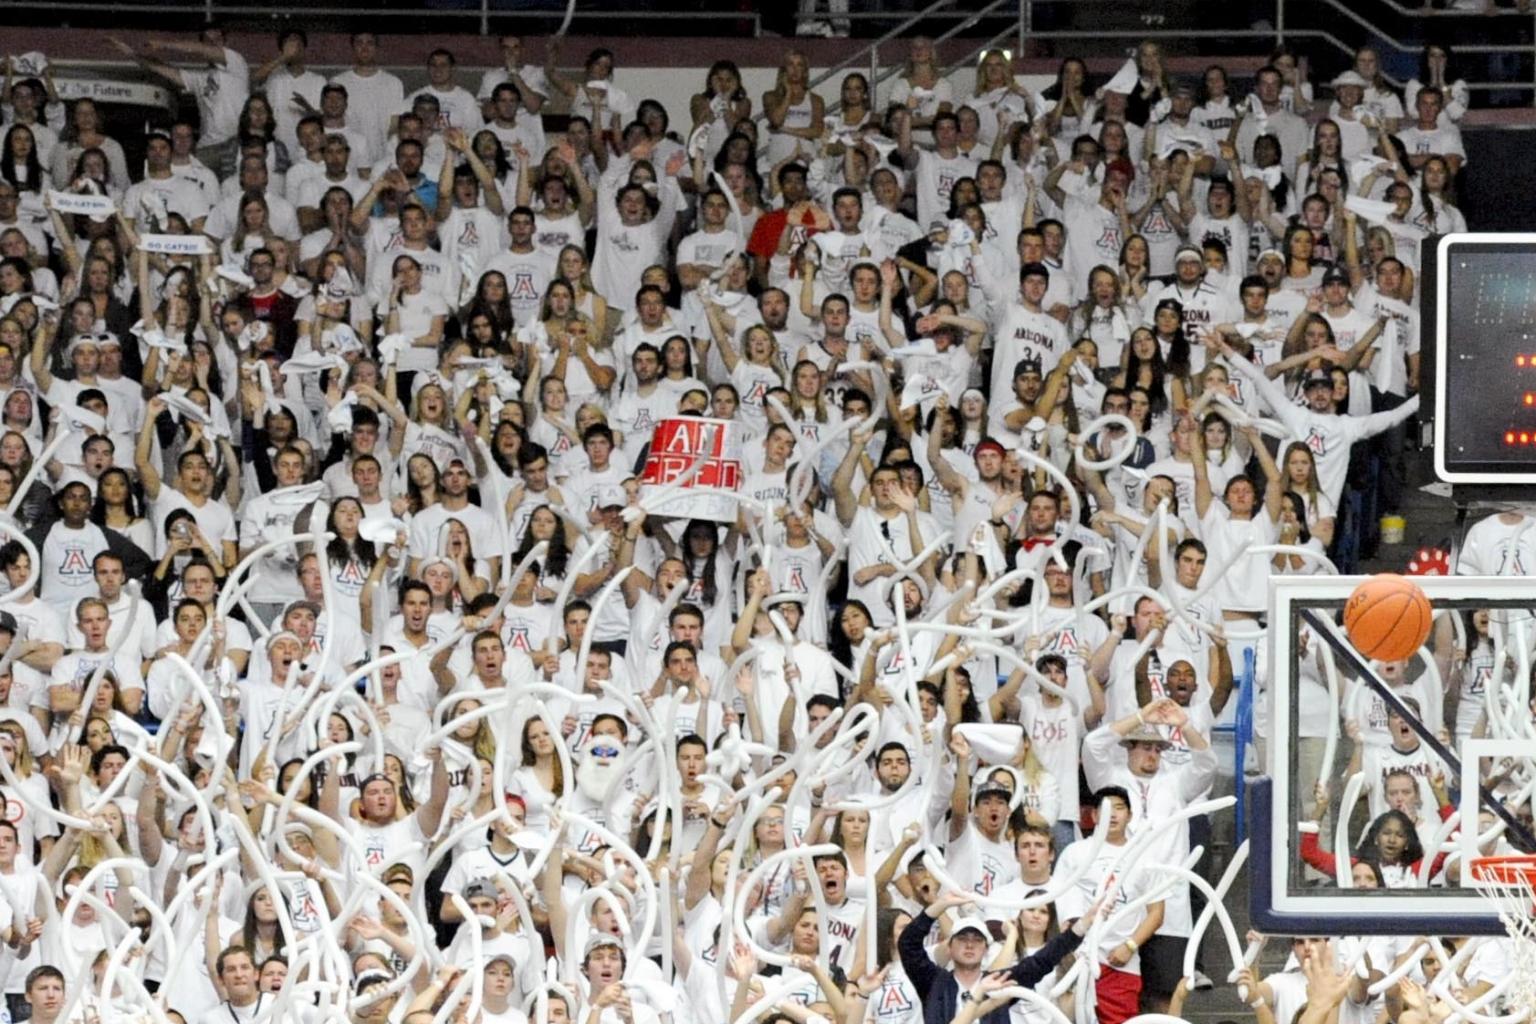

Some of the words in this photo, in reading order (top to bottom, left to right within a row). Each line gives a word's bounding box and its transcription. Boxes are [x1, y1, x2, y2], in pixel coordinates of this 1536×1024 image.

[1145, 211, 1170, 234] A
[511, 274, 538, 299] A
[1014, 328, 1054, 351] ARIZONA
[1304, 427, 1327, 457] A
[58, 549, 99, 574] A
[336, 558, 371, 586] A
[507, 627, 534, 654] A
[1053, 628, 1079, 655] A
[878, 981, 913, 1016] A
